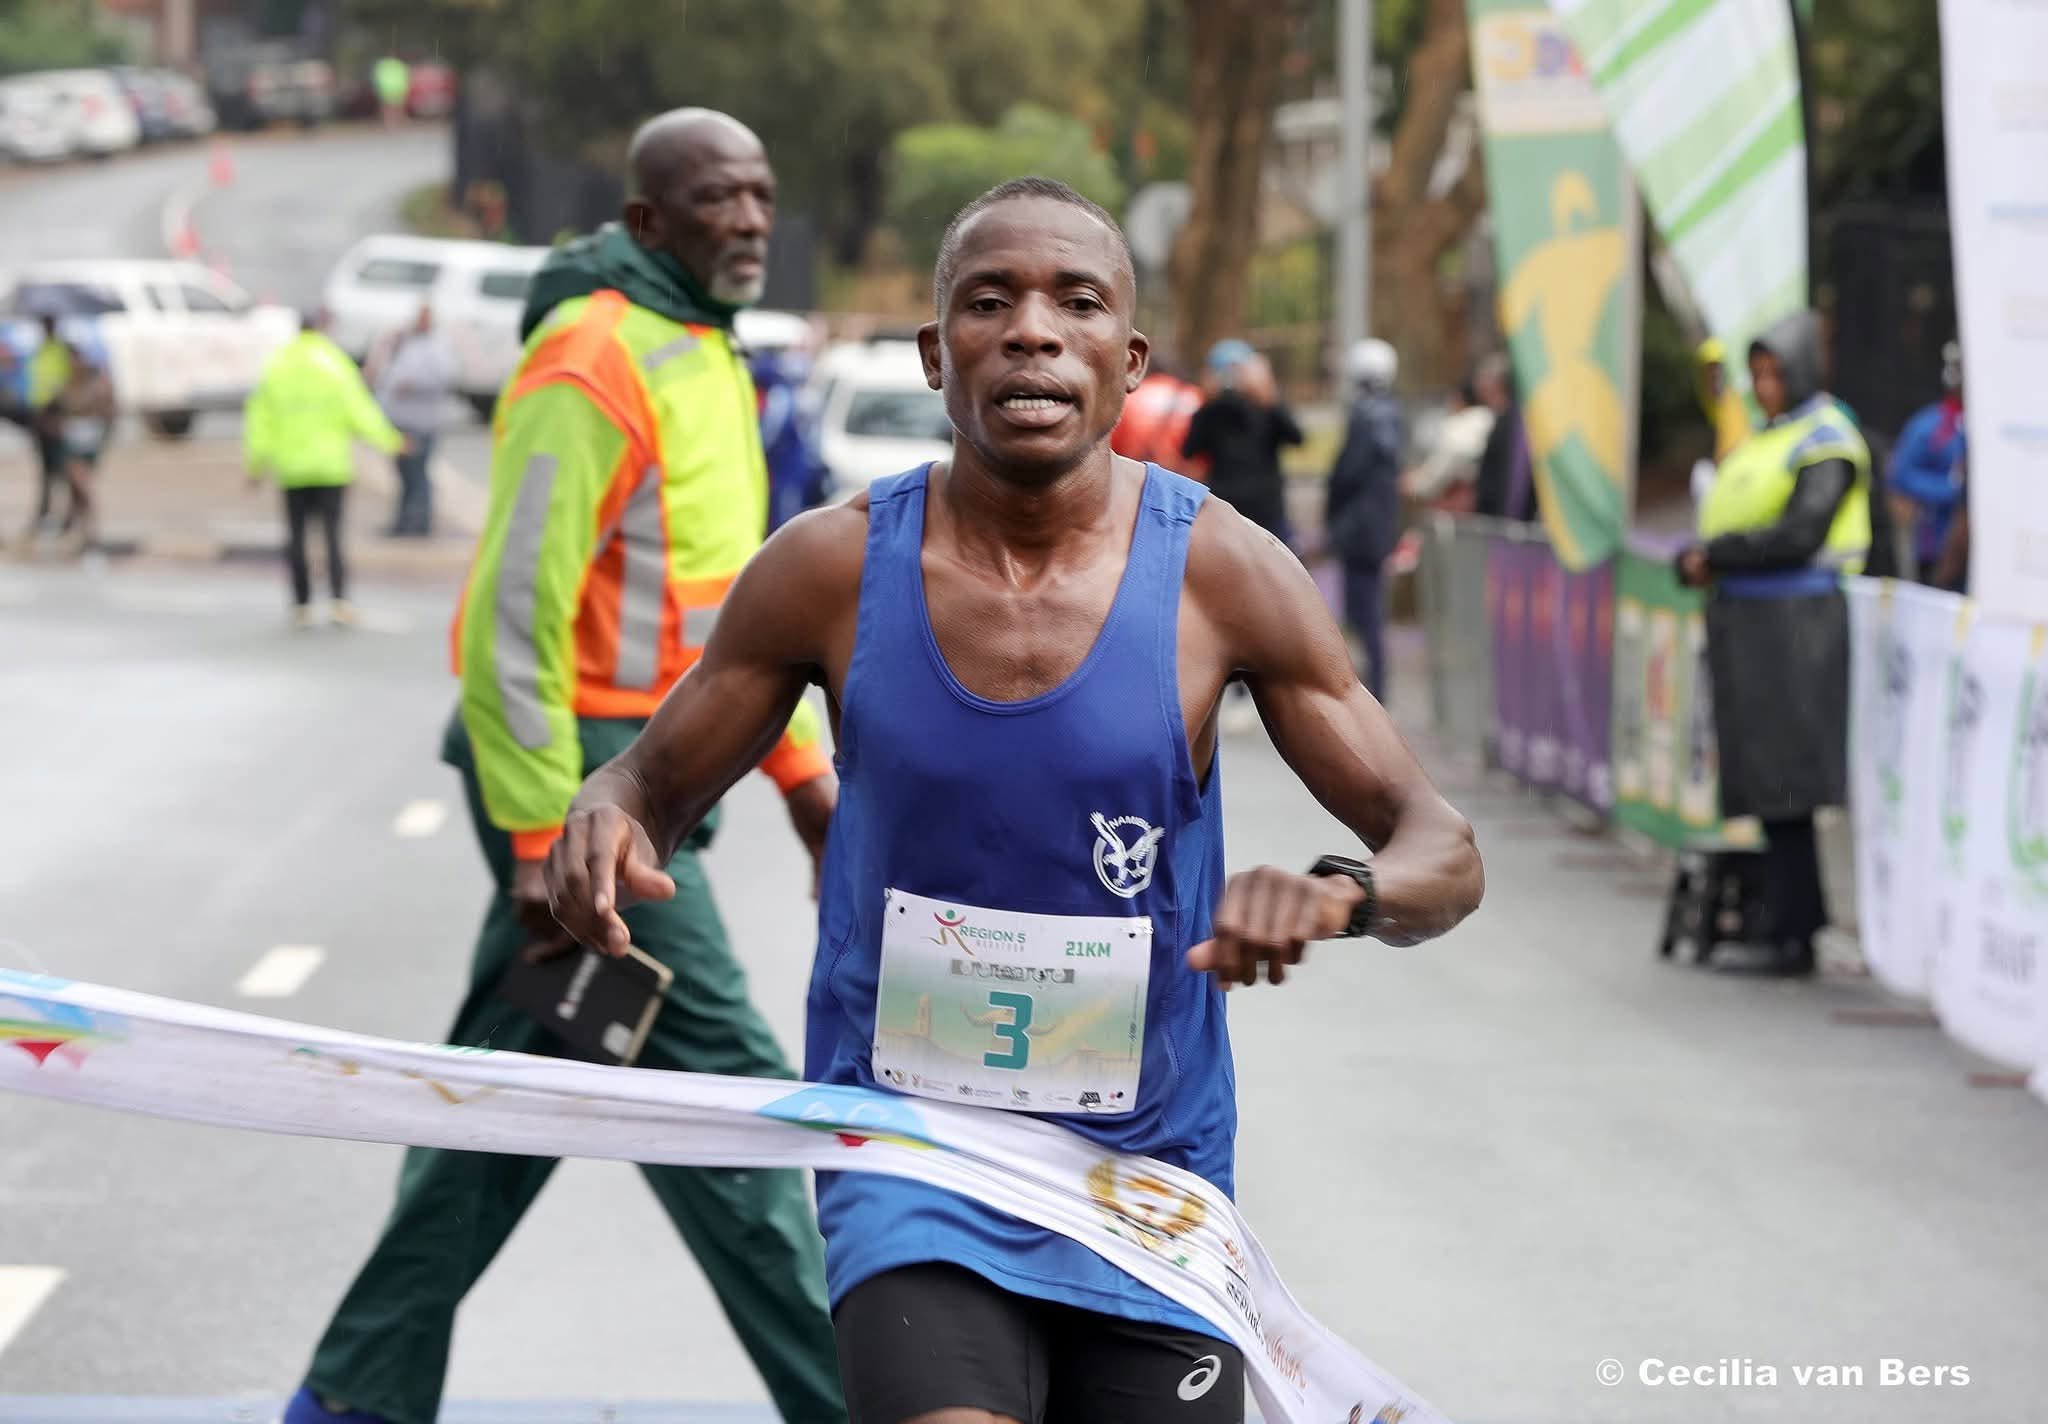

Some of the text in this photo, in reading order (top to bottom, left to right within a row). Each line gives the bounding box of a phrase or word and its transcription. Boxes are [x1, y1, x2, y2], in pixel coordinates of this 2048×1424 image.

[960, 925, 1013, 942] REGION
[1065, 941, 1111, 957] 21KM
[983, 990, 1033, 1070] 3
